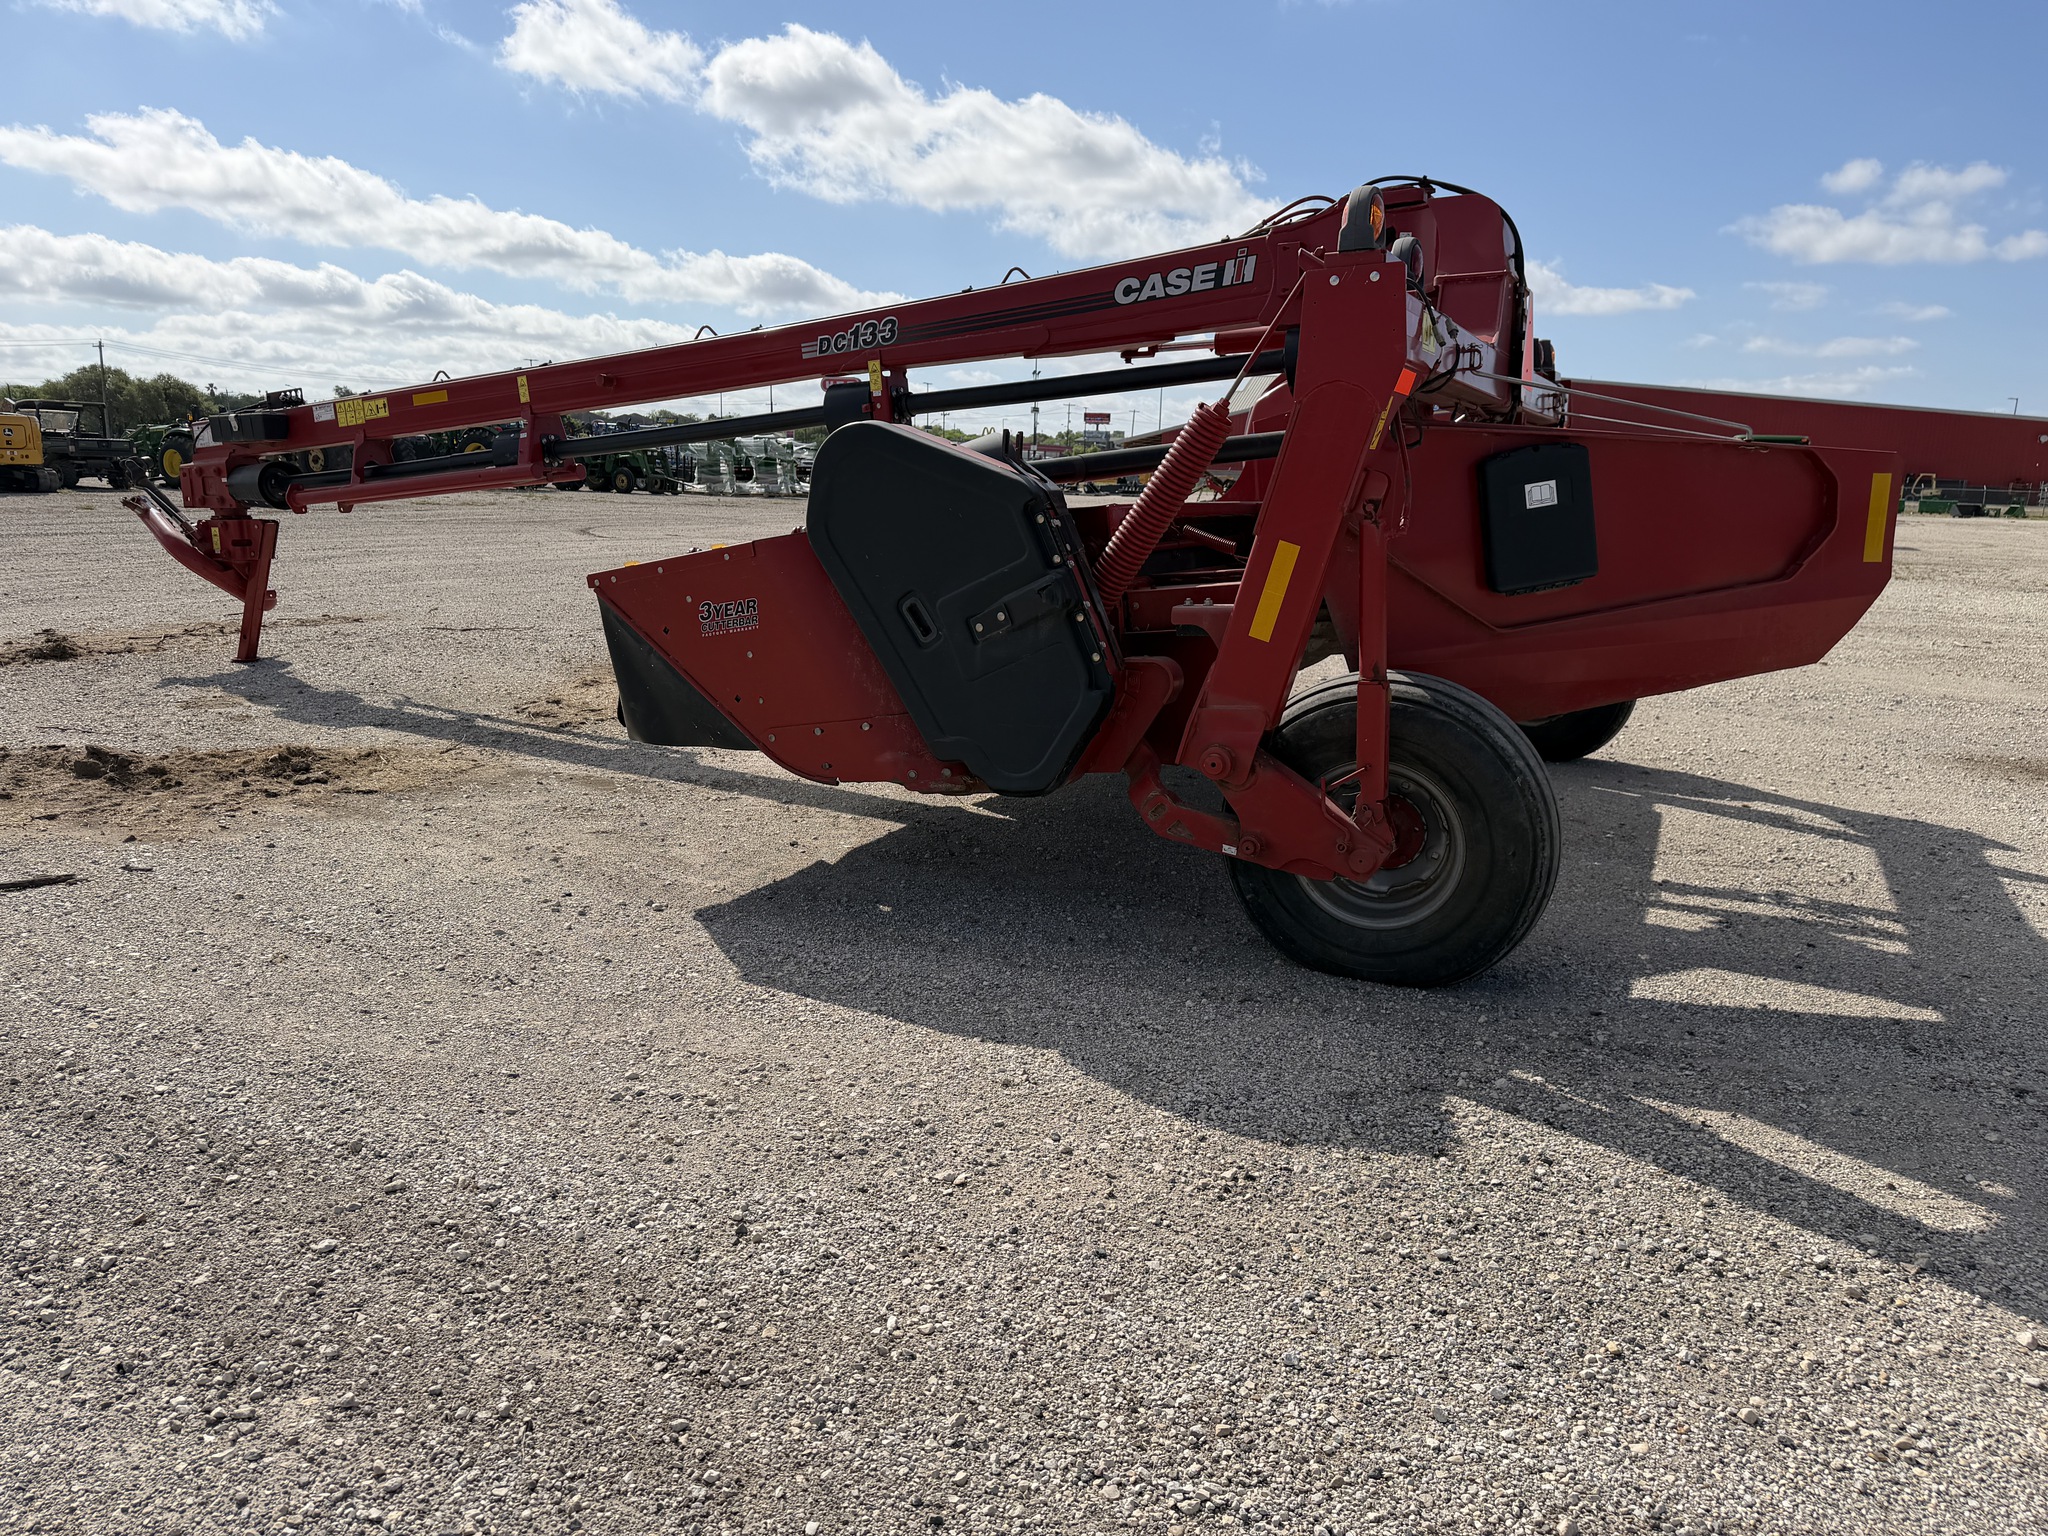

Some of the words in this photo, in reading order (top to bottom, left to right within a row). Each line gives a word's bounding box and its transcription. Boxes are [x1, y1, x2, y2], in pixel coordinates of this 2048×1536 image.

[1114, 262, 1218, 305] CASE
[816, 316, 898, 356] DC133
[701, 615, 759, 633] CUTTERBAR
[729, 625, 759, 634] WARRANTY
